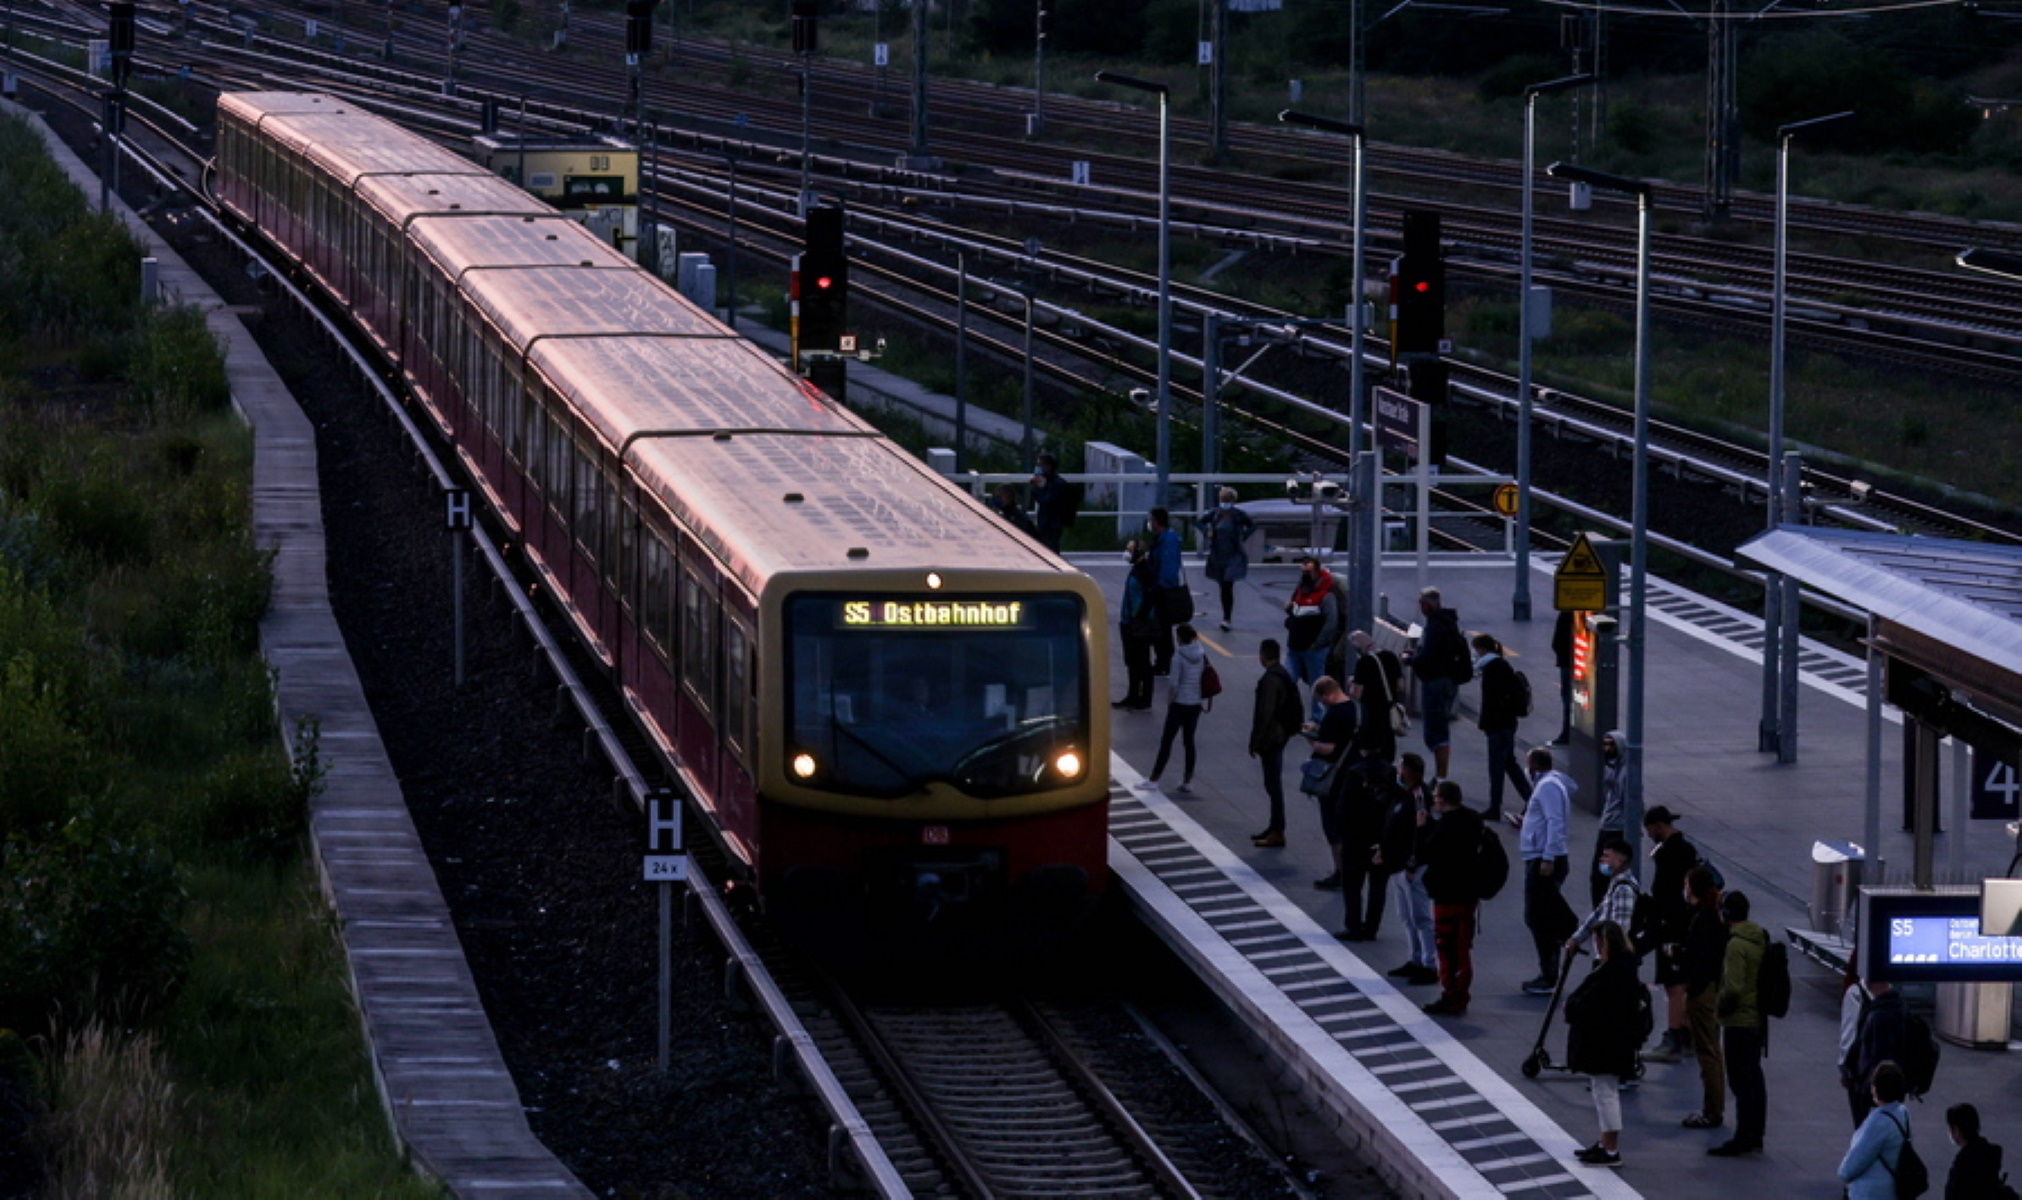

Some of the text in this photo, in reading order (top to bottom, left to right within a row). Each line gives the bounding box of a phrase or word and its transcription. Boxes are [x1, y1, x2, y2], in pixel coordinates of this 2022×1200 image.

[447, 491, 470, 528] H
[844, 601, 1021, 624] S5 Ostbahnhof
[1984, 760, 2020, 805] 4
[648, 798, 684, 850] H
[652, 861, 668, 875] 24
[1891, 918, 1914, 937] S5
